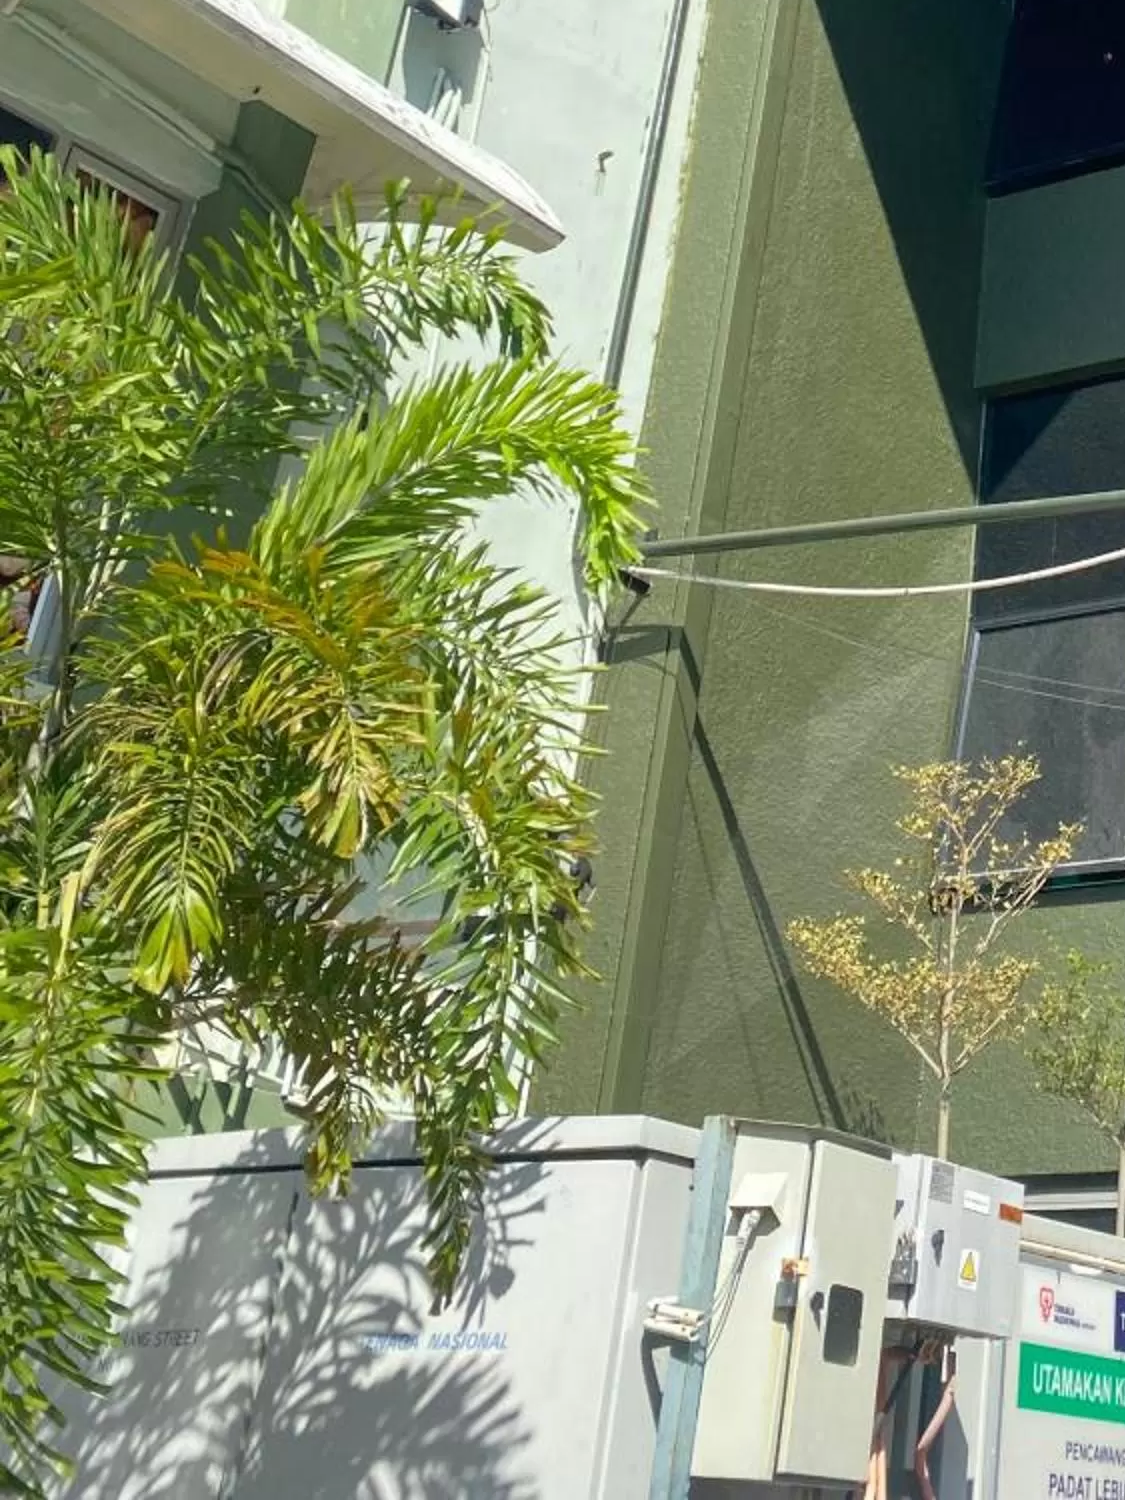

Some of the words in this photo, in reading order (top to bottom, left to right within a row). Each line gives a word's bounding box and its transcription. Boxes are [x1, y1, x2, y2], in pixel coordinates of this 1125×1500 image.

[154, 1328, 200, 1348] STREET
[428, 1331, 508, 1349] NASIONAL
[1033, 1362, 1112, 1405] UTAMAKAN
[1049, 1473, 1093, 1500] PADAT
